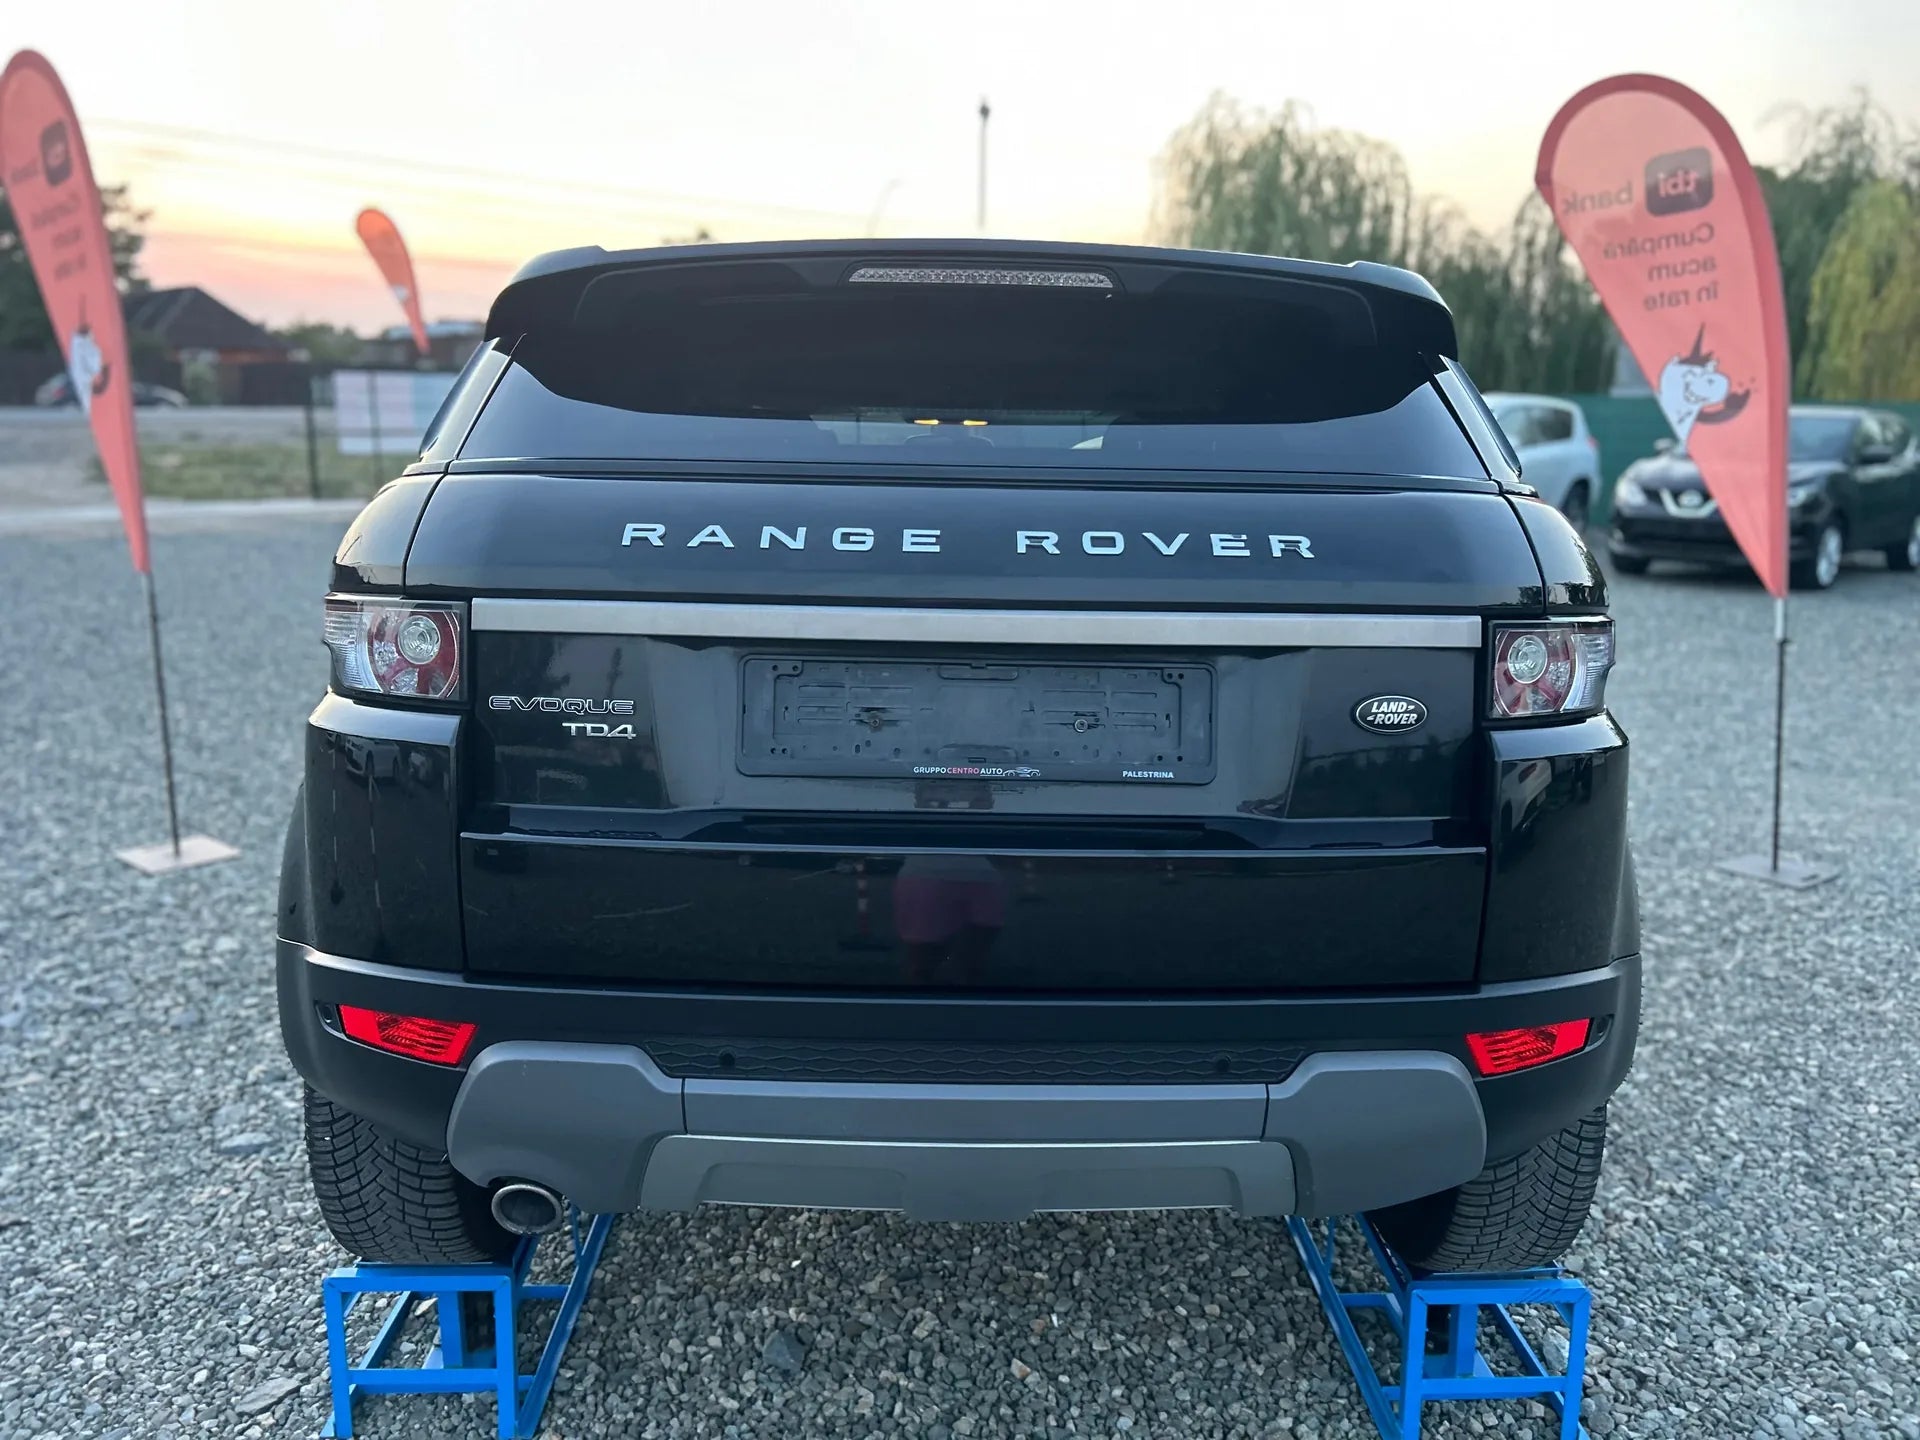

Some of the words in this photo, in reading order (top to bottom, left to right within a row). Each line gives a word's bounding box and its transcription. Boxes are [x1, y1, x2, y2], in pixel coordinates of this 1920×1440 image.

[621, 522, 942, 554] RANGE
[1016, 529, 1316, 559] ROVER
[488, 695, 634, 716] EVOQUE
[1371, 701, 1407, 713] LAND
[1373, 713, 1418, 725] ROVER
[562, 722, 637, 740] TD4
[1122, 770, 1175, 779] PALESTRINA
